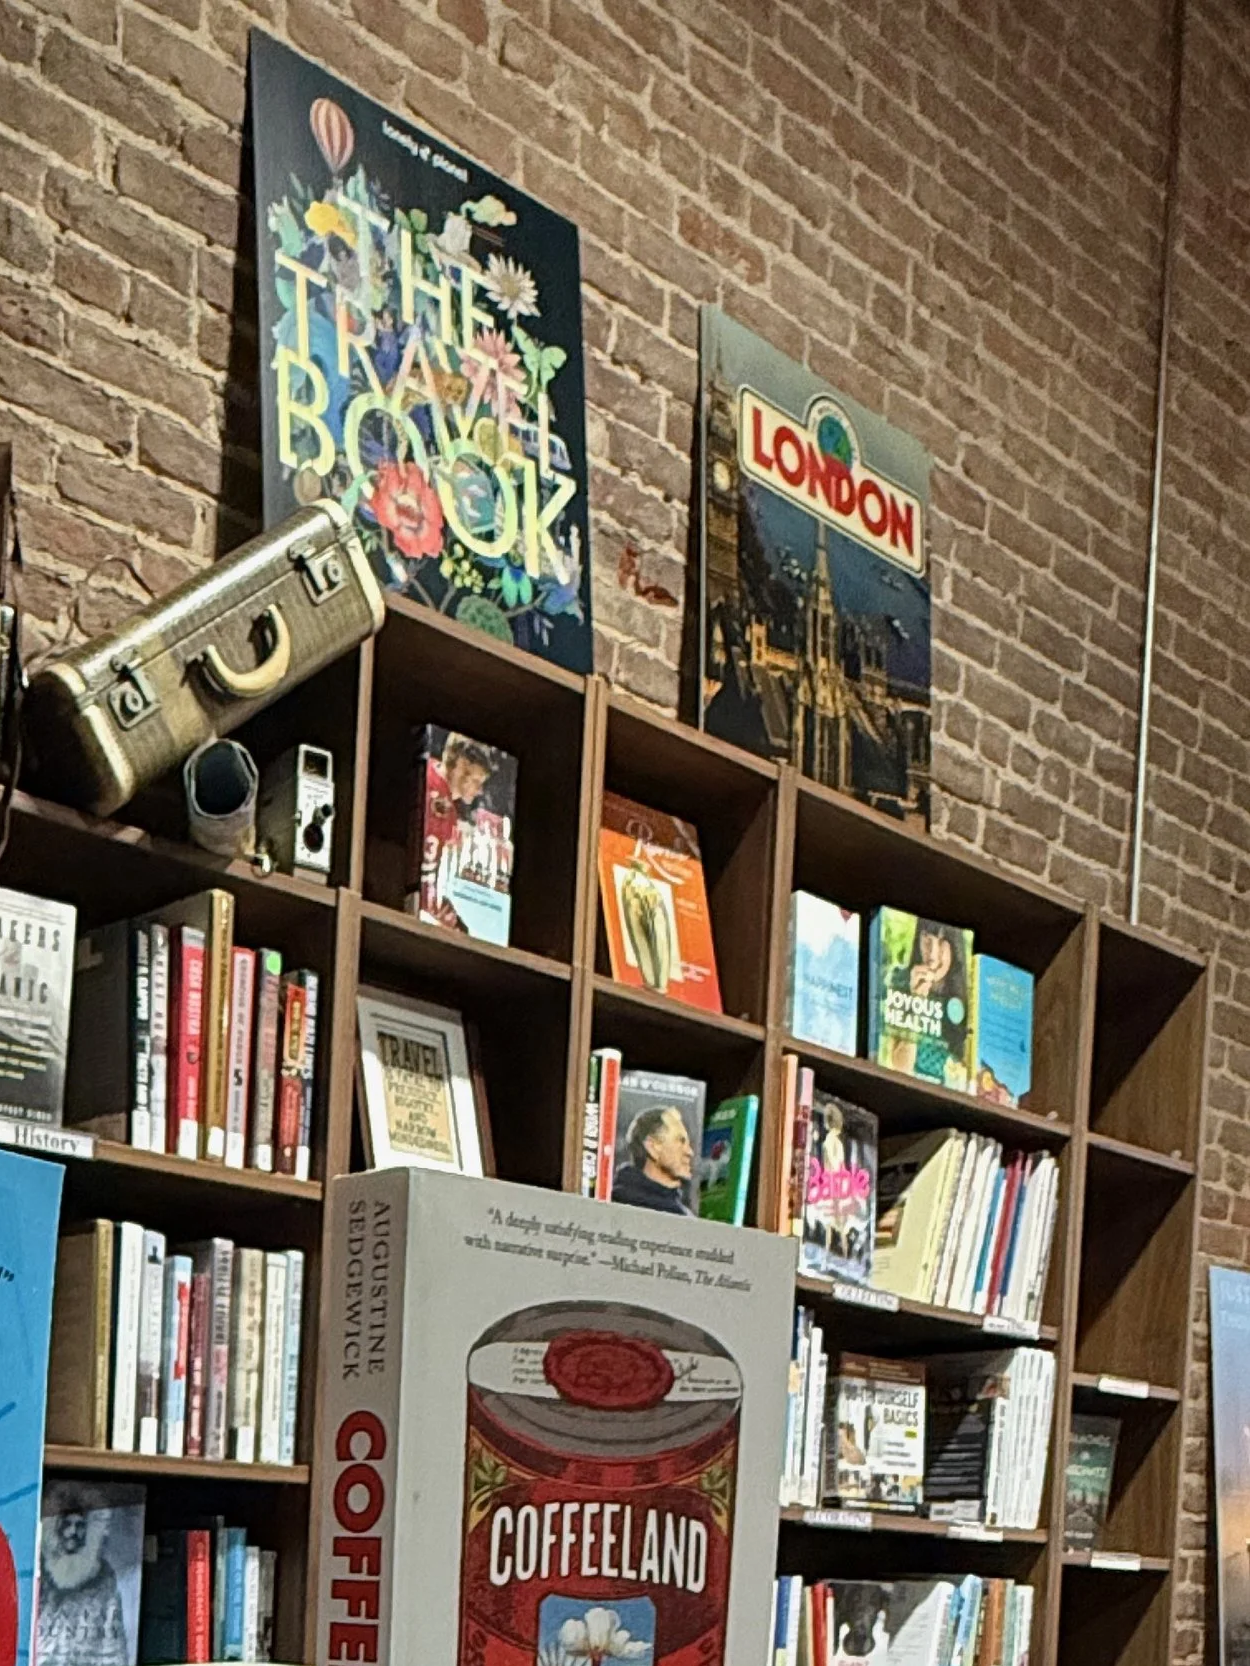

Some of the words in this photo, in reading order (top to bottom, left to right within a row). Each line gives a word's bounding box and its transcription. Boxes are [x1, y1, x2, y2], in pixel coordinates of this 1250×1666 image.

[276, 349, 578, 587] BOOK
[751, 405, 914, 558] LONDON
[883, 1008, 943, 1037] HEALTH
[885, 988, 944, 1020] JOYOUS
[377, 1030, 444, 1082] TRAVEL
[13, 1123, 82, 1154] History
[807, 1156, 870, 1203] Barbie
[505, 1211, 542, 1237] deeply
[463, 1233, 492, 1250] with
[694, 1269, 714, 1287] The
[340, 1200, 366, 1382] SEDGEWICK
[366, 1200, 392, 1376] AUGUSTINE
[883, 1407, 919, 1427] BASICS
[488, 1502, 709, 1595] COFFEELAND
